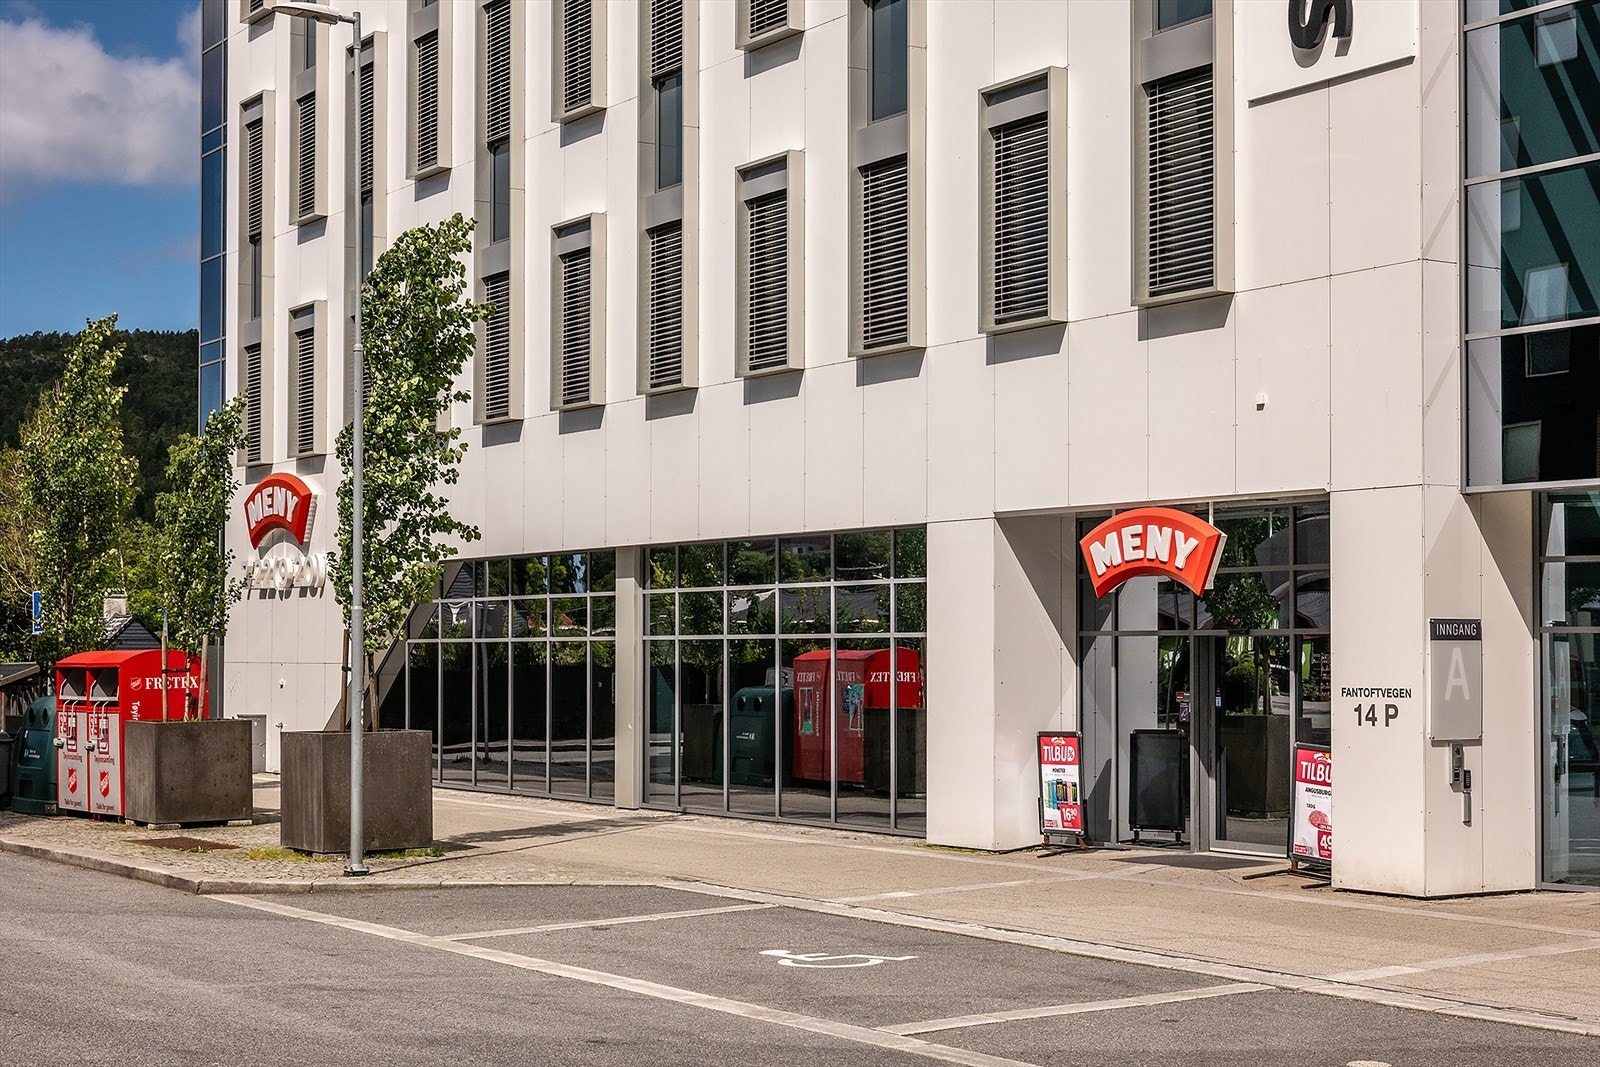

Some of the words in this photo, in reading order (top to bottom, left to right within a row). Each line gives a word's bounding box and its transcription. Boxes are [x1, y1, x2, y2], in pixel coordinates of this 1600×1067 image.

[247, 486, 299, 530] MENY
[1089, 524, 1200, 576] MENY
[1436, 623, 1477, 636] INNGANG
[1444, 647, 1470, 701] A
[1341, 687, 1412, 699] FANTOFTVEGEN
[1354, 704, 1378, 727] 14
[1385, 704, 1399, 727] P
[1042, 745, 1075, 762] TILBUD
